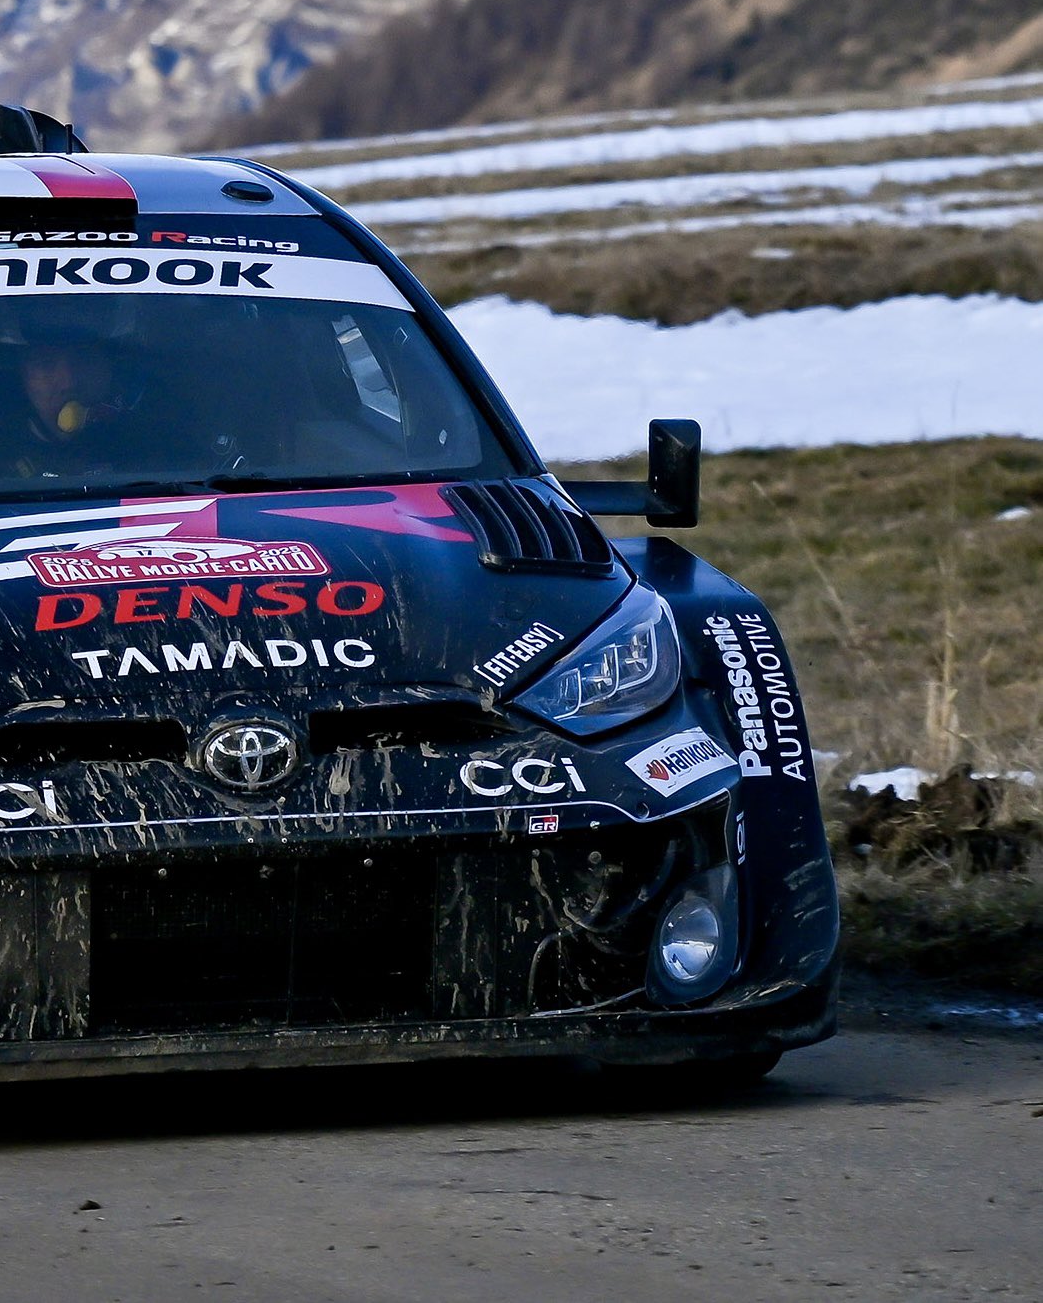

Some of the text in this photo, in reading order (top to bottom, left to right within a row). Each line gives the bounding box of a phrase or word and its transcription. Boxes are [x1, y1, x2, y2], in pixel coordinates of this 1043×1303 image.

[151, 231, 300, 253] Racing
[42, 551, 317, 583] RALLYE MONTE-CARLO
[34, 580, 385, 632] DENSO
[71, 638, 376, 679] TAMADIC
[702, 615, 773, 778] Panasonic
[735, 613, 807, 782] AUTOMOTIVE
[529, 819, 557, 833] GR
